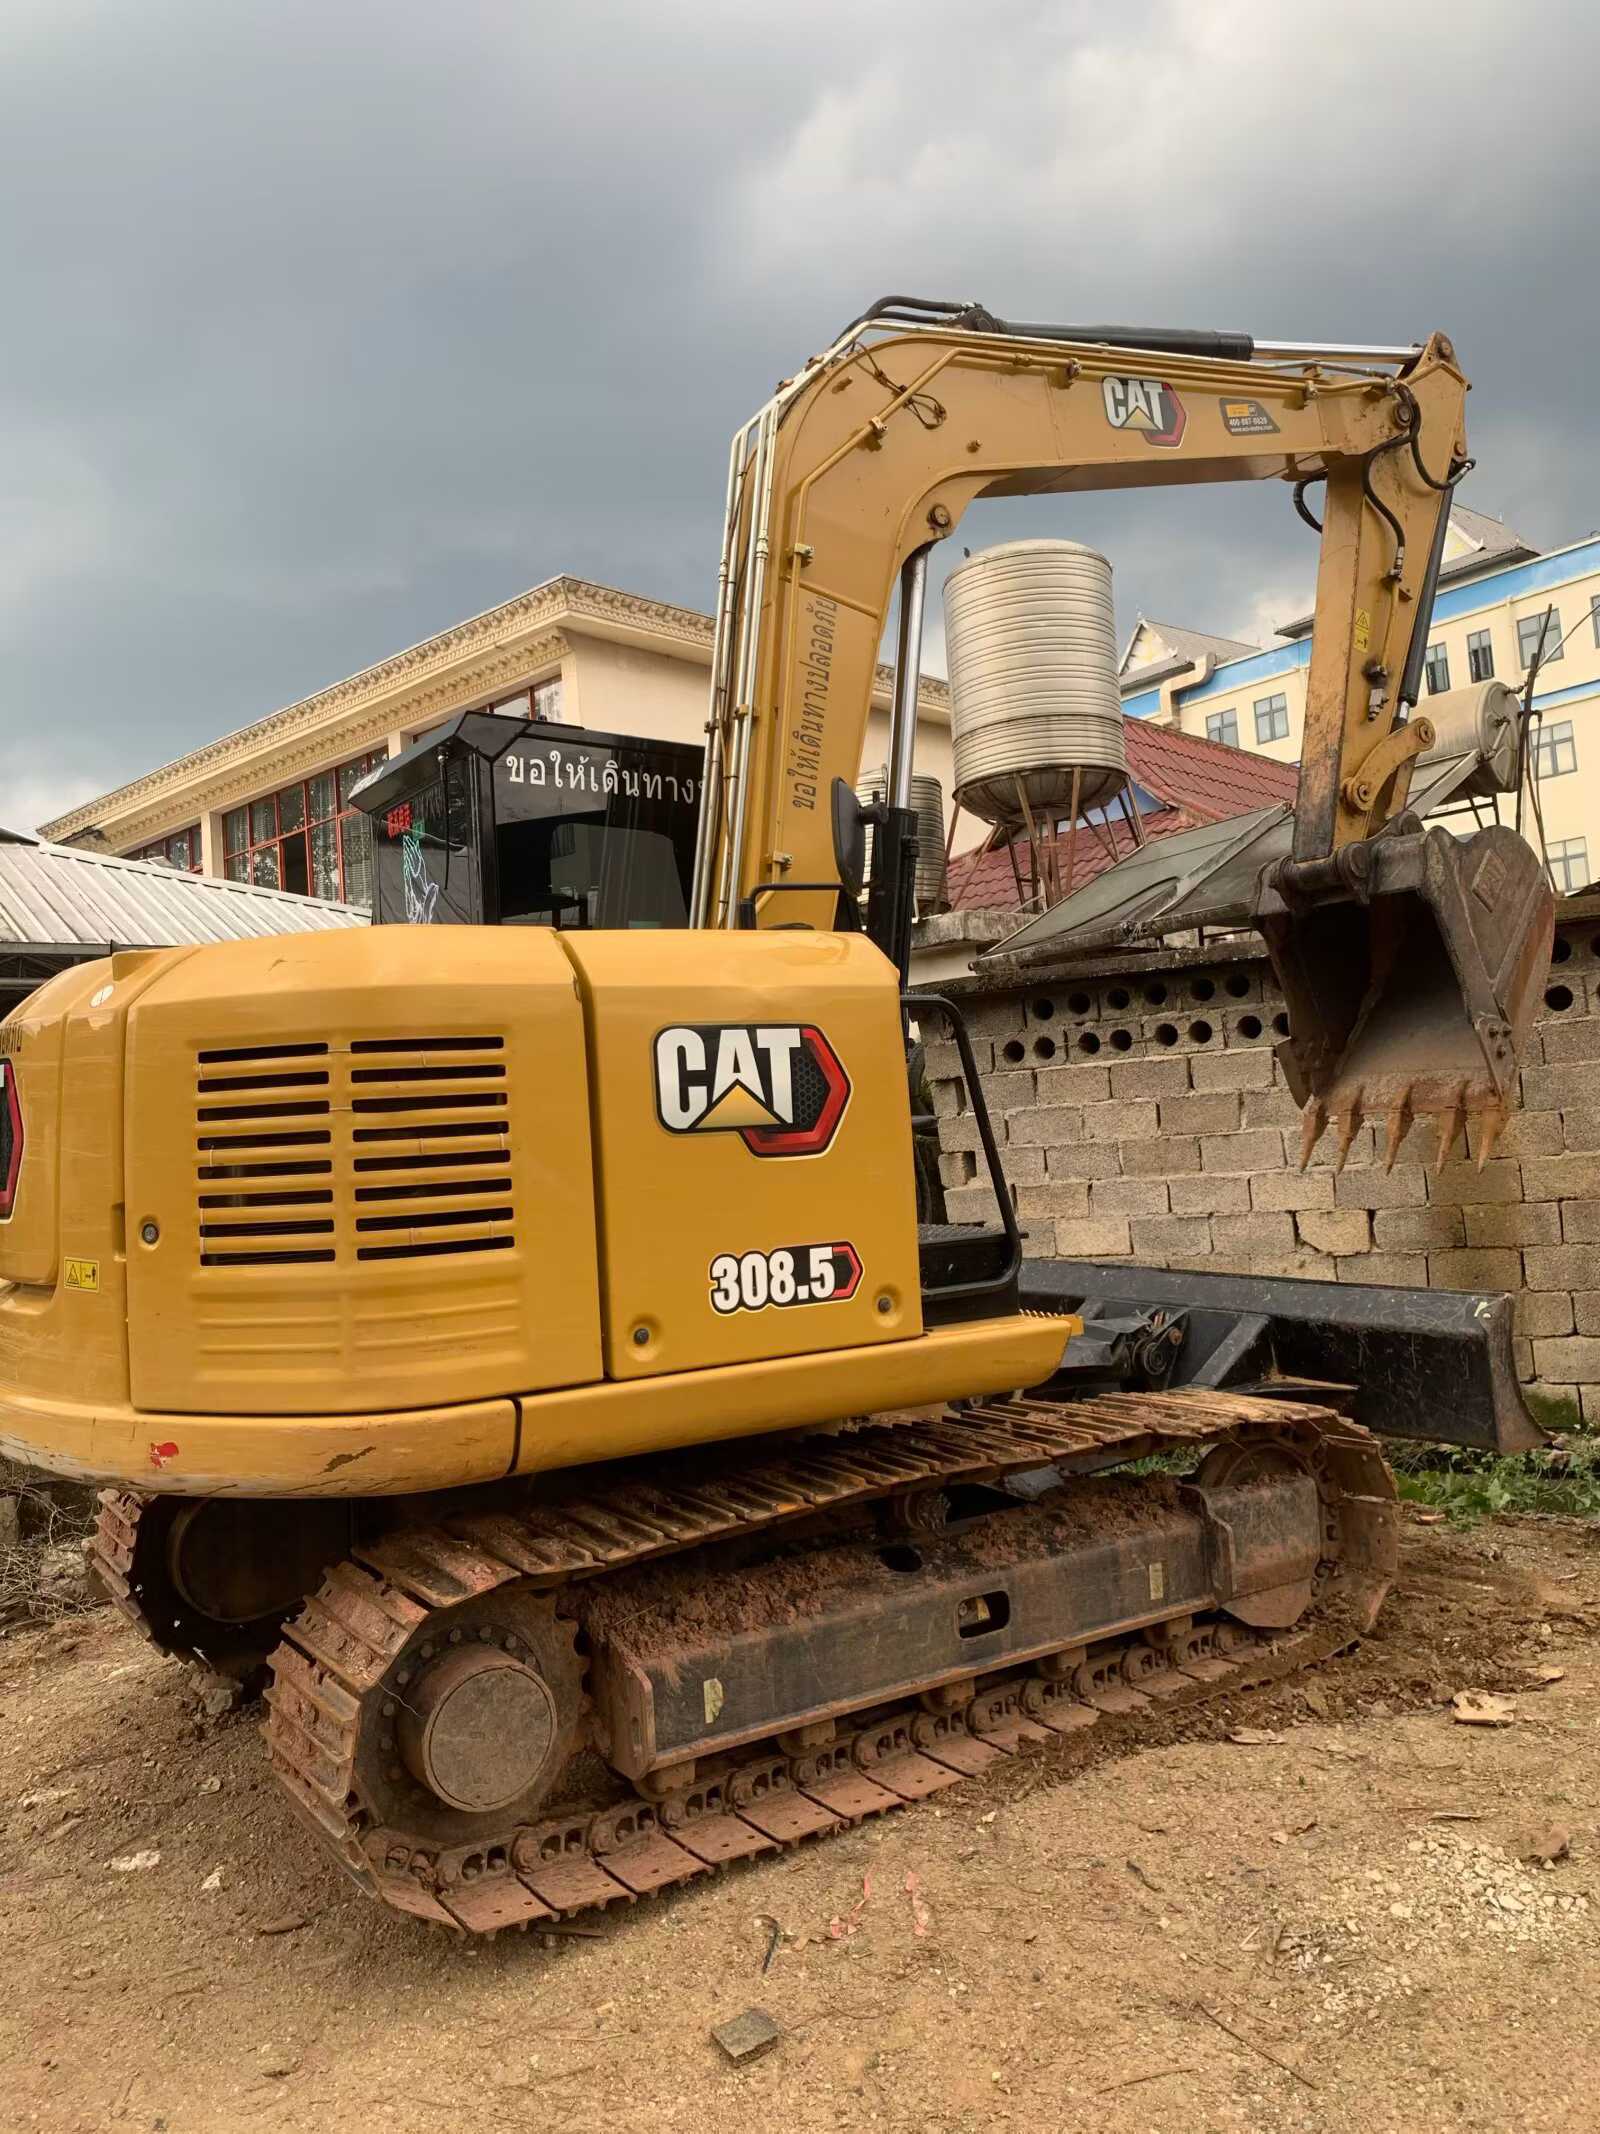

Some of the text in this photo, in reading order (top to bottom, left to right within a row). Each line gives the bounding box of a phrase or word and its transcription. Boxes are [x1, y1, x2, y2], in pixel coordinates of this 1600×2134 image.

[1103, 376, 1164, 431] CAT
[506, 750, 703, 804] ขอให้เดินทาง
[656, 1028, 801, 1130] CAT
[711, 1246, 836, 1311] 308.5
